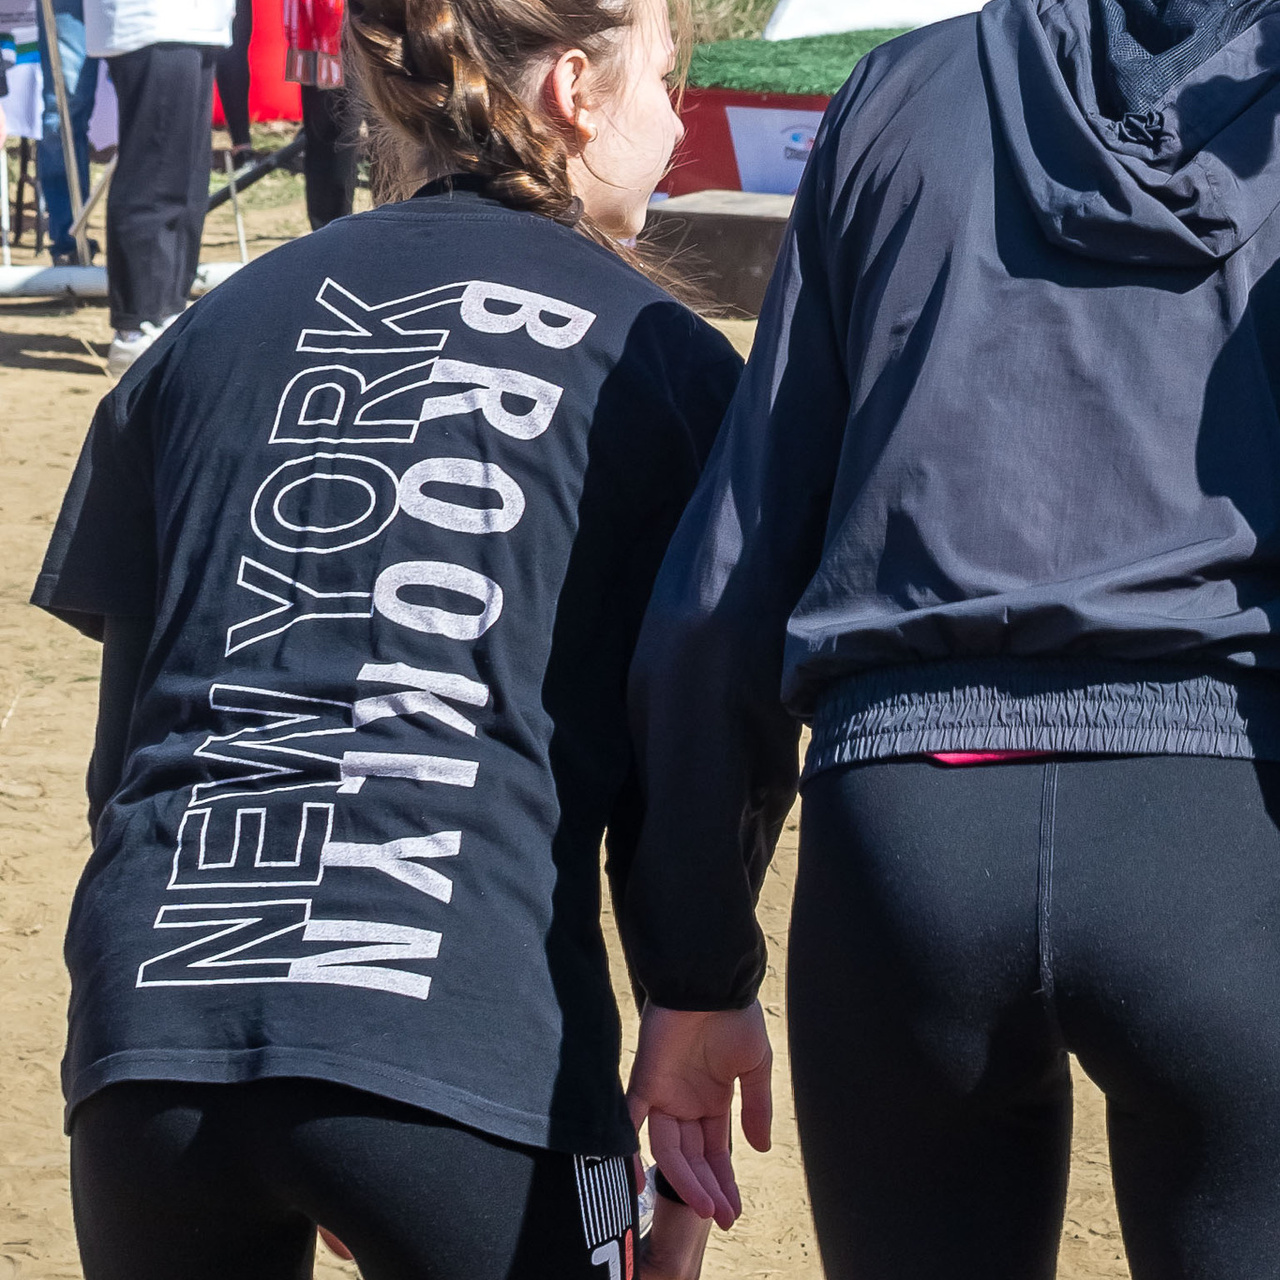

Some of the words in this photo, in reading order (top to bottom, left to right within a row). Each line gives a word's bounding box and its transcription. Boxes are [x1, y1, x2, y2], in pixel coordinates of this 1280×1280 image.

[225, 277, 474, 658] YORK
[288, 280, 596, 1000] BROOKLYN
[136, 684, 357, 988] NEW
